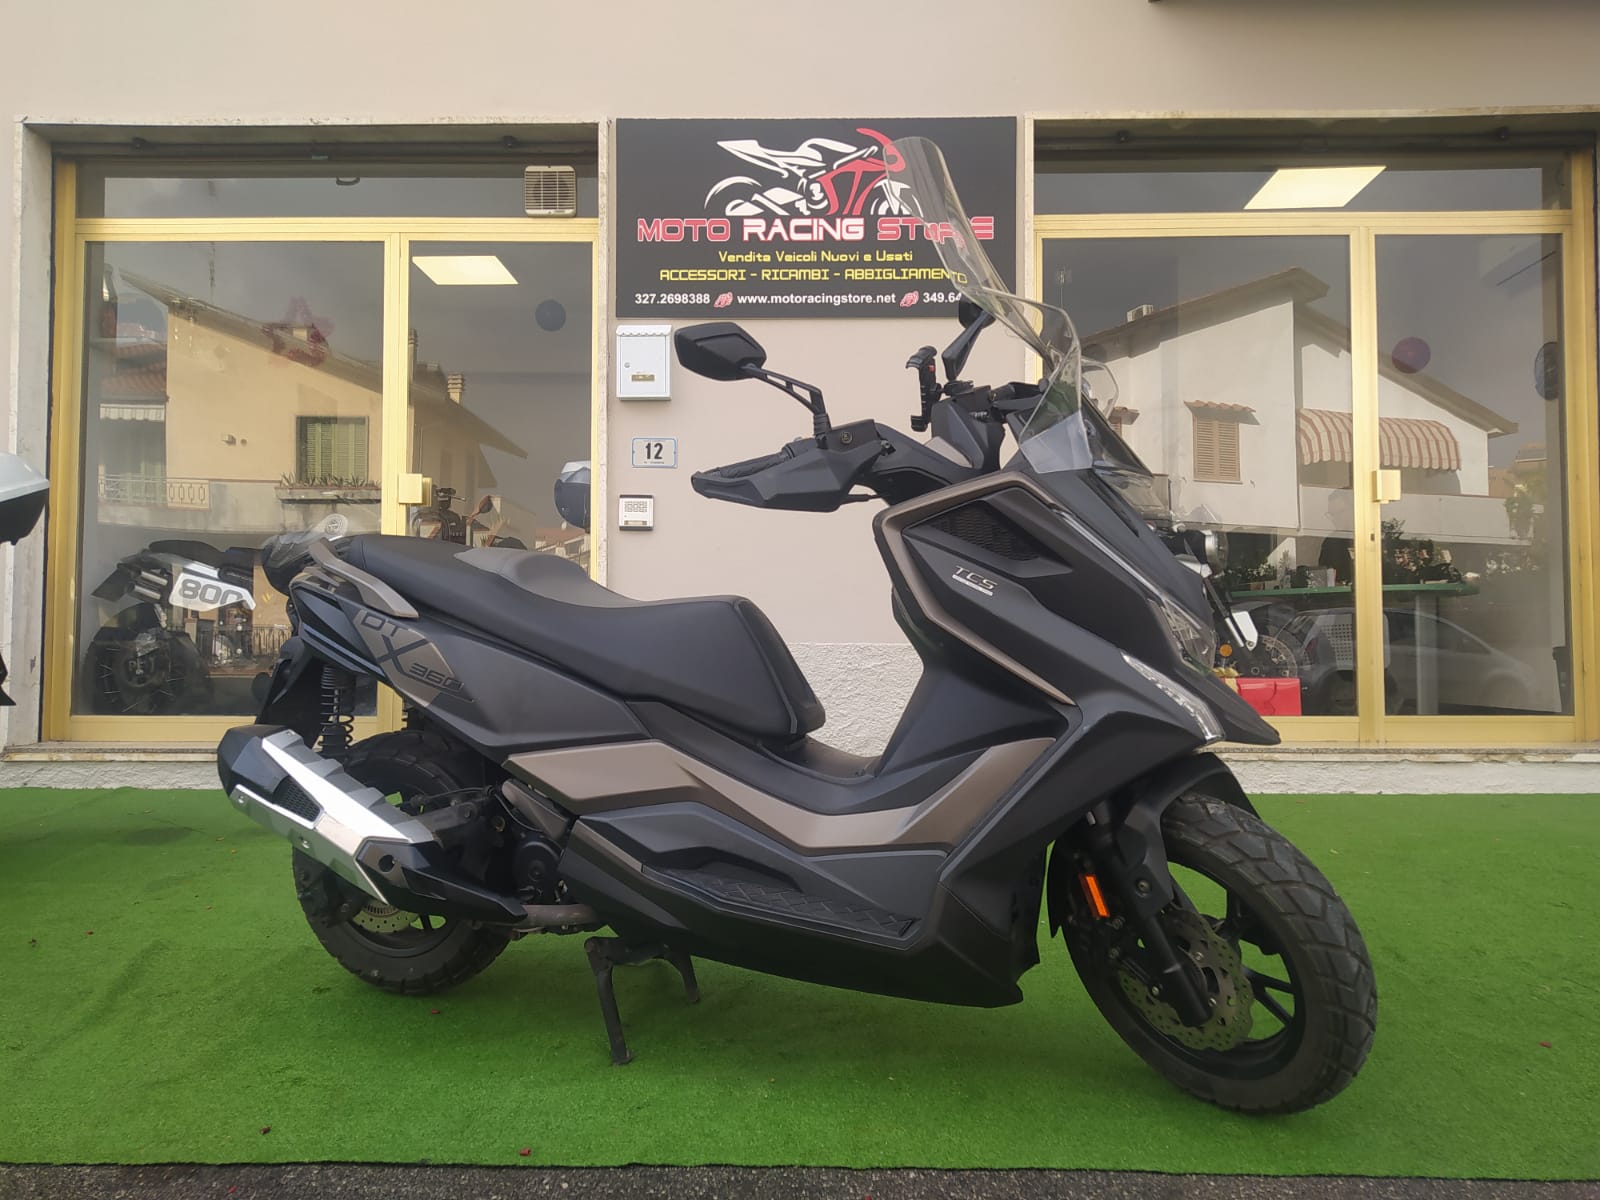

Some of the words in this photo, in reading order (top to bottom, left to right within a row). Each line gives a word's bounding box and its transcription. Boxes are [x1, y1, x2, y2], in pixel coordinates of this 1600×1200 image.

[637, 218, 730, 242] MOTO
[742, 217, 865, 242] RACING
[718, 250, 771, 262] Vendita
[775, 250, 817, 262] Veicoli
[821, 250, 860, 262] Nuovi
[863, 253, 872, 262] e
[876, 250, 913, 262] Usati
[659, 269, 746, 281] ACCESSORI
[761, 268, 829, 281] RICAMBI
[845, 268, 968, 284] ABBIGLIAMENTO
[634, 293, 711, 305] 327.2698388
[737, 293, 896, 306] www.motoracingstore.net
[645, 442, 663, 460] 12
[954, 565, 998, 590] TCS
